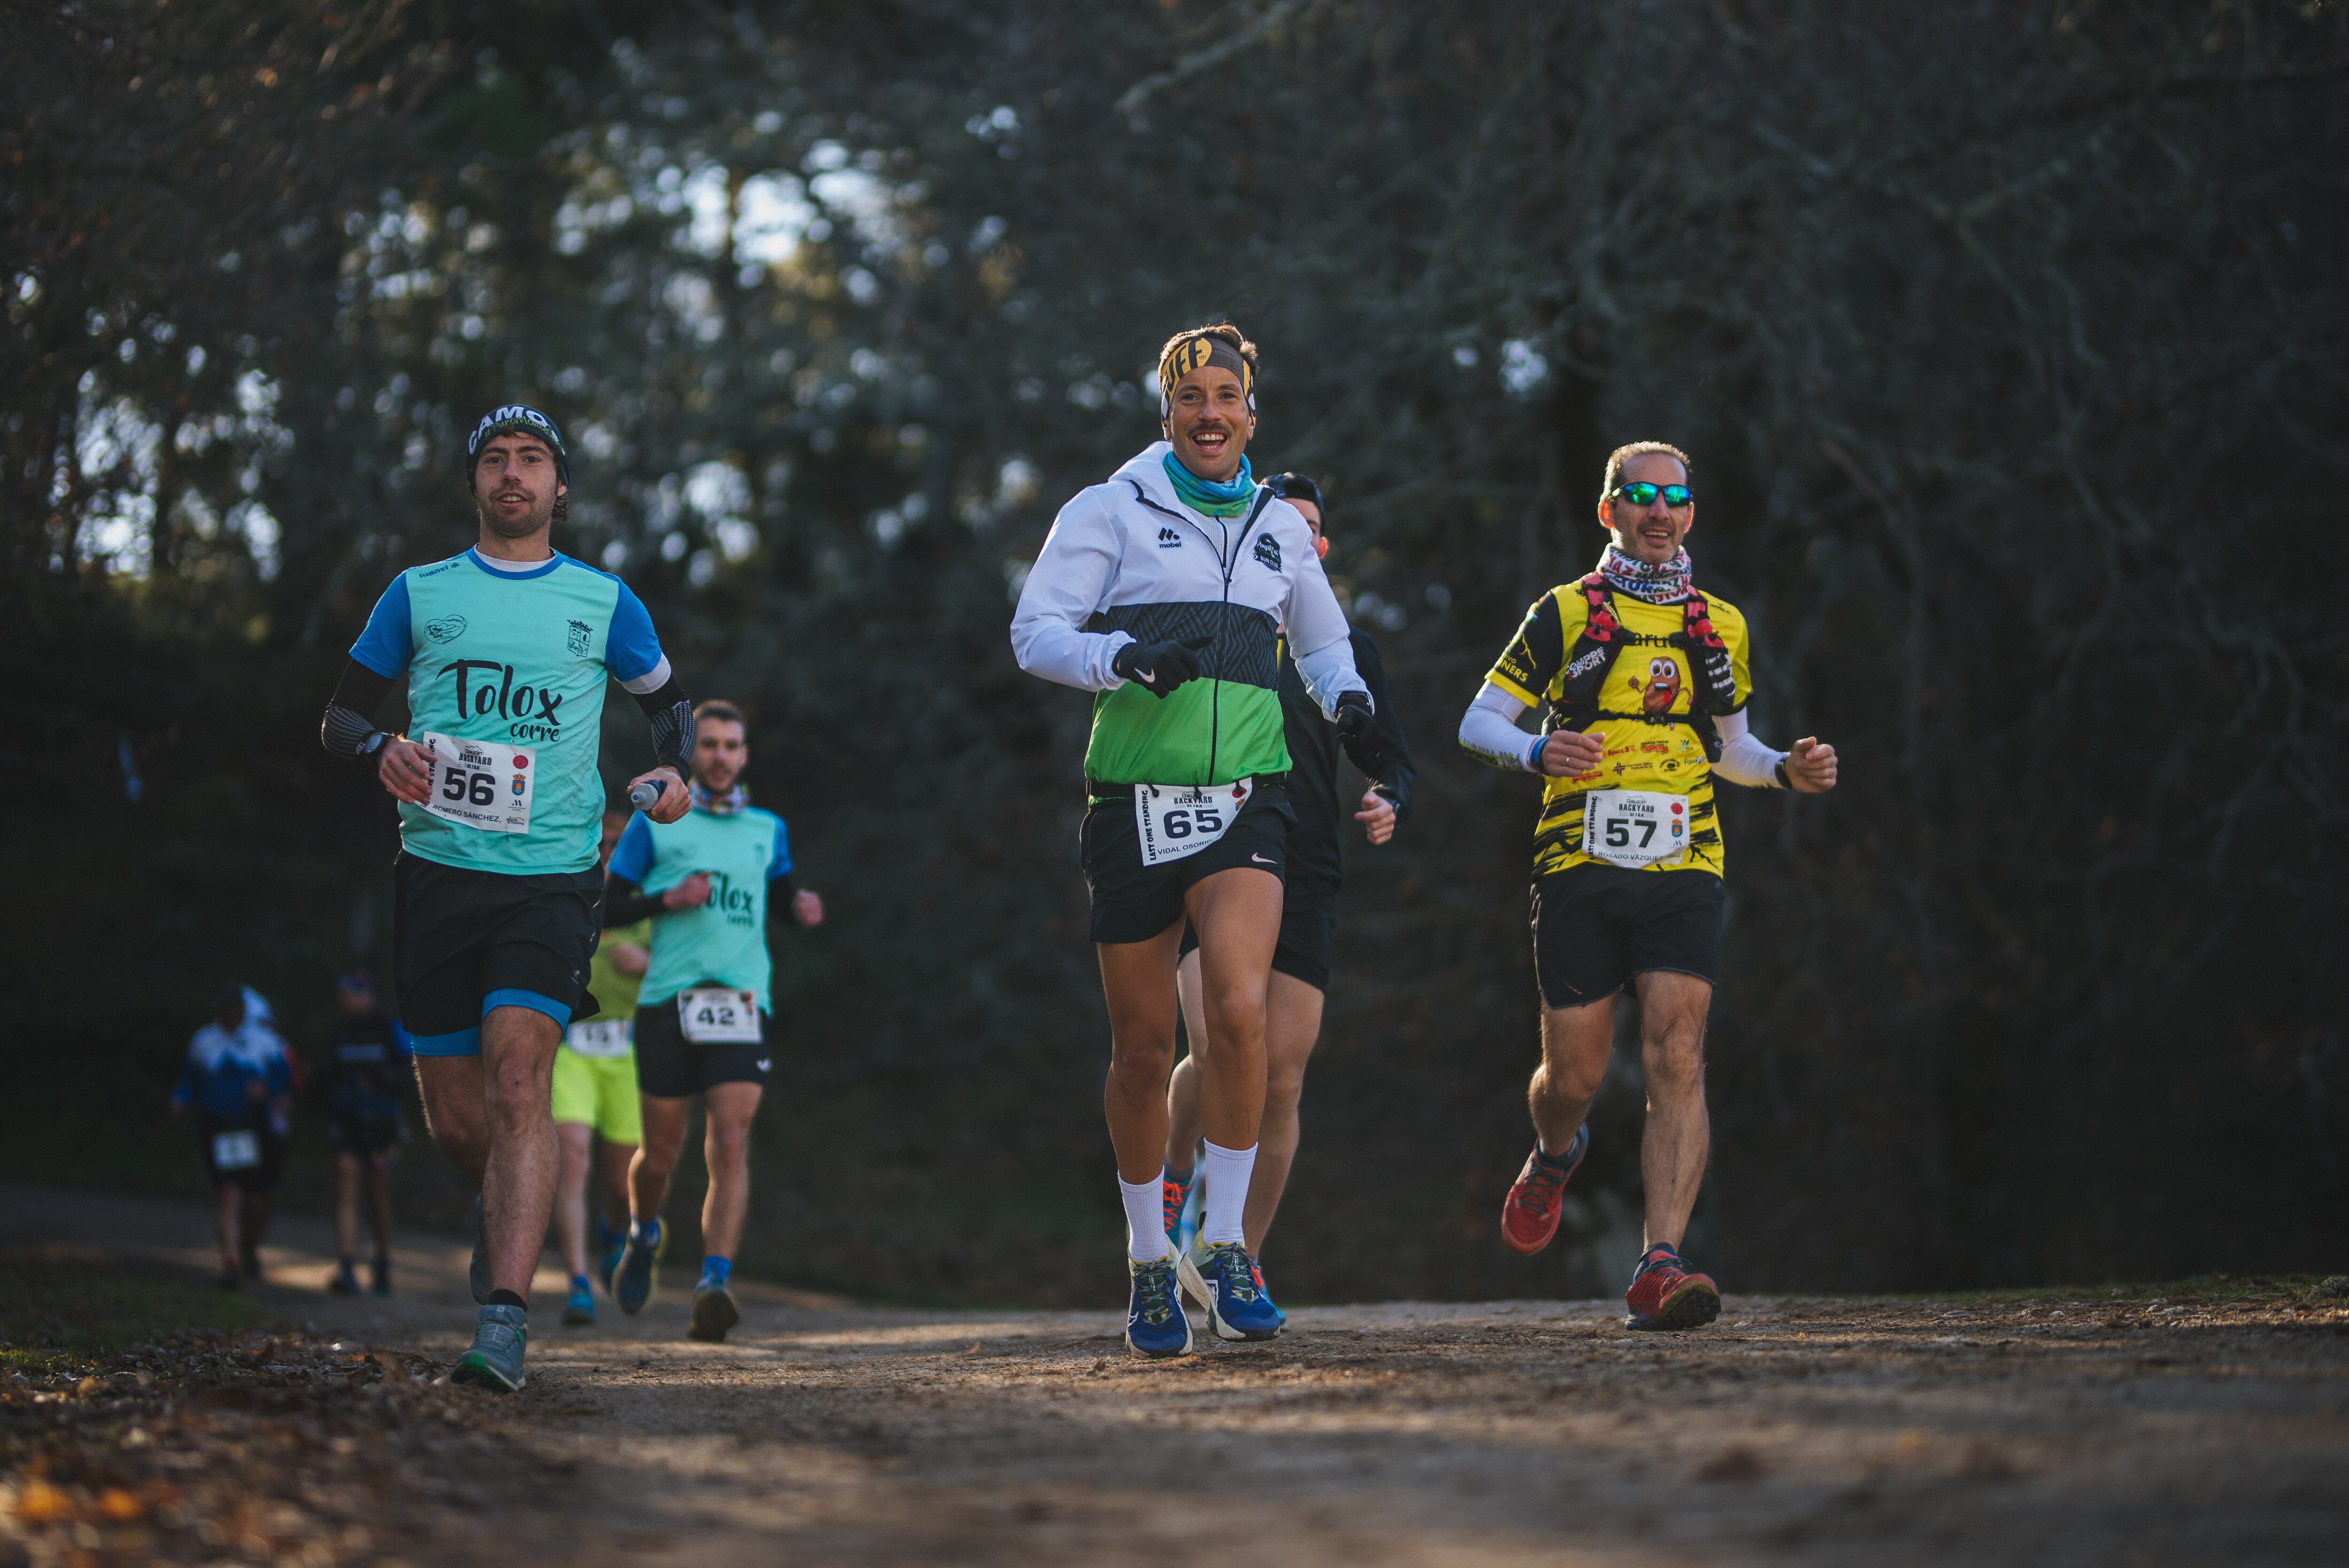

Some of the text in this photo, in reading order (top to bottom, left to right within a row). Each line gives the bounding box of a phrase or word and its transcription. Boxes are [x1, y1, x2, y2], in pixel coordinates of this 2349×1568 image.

[1163, 337, 1202, 392] UFF
[419, 565, 449, 578] luanvi
[1501, 660, 1528, 682] NERS
[436, 659, 562, 726] Tolox
[510, 723, 560, 742] corre
[459, 753, 492, 765] BACKYARD
[443, 766, 496, 806] 56
[432, 805, 462, 816] ROMERO
[1142, 790, 1151, 826] STANDING
[1589, 796, 1598, 830] STANDING
[1619, 803, 1654, 812] BACKYARD
[1163, 809, 1222, 838] 65
[1605, 818, 1657, 848] 57
[1147, 844, 1156, 861] LAST
[1158, 846, 1181, 855] VIDAL
[1598, 851, 1628, 859] ROSADO
[697, 1007, 736, 1026] 42
